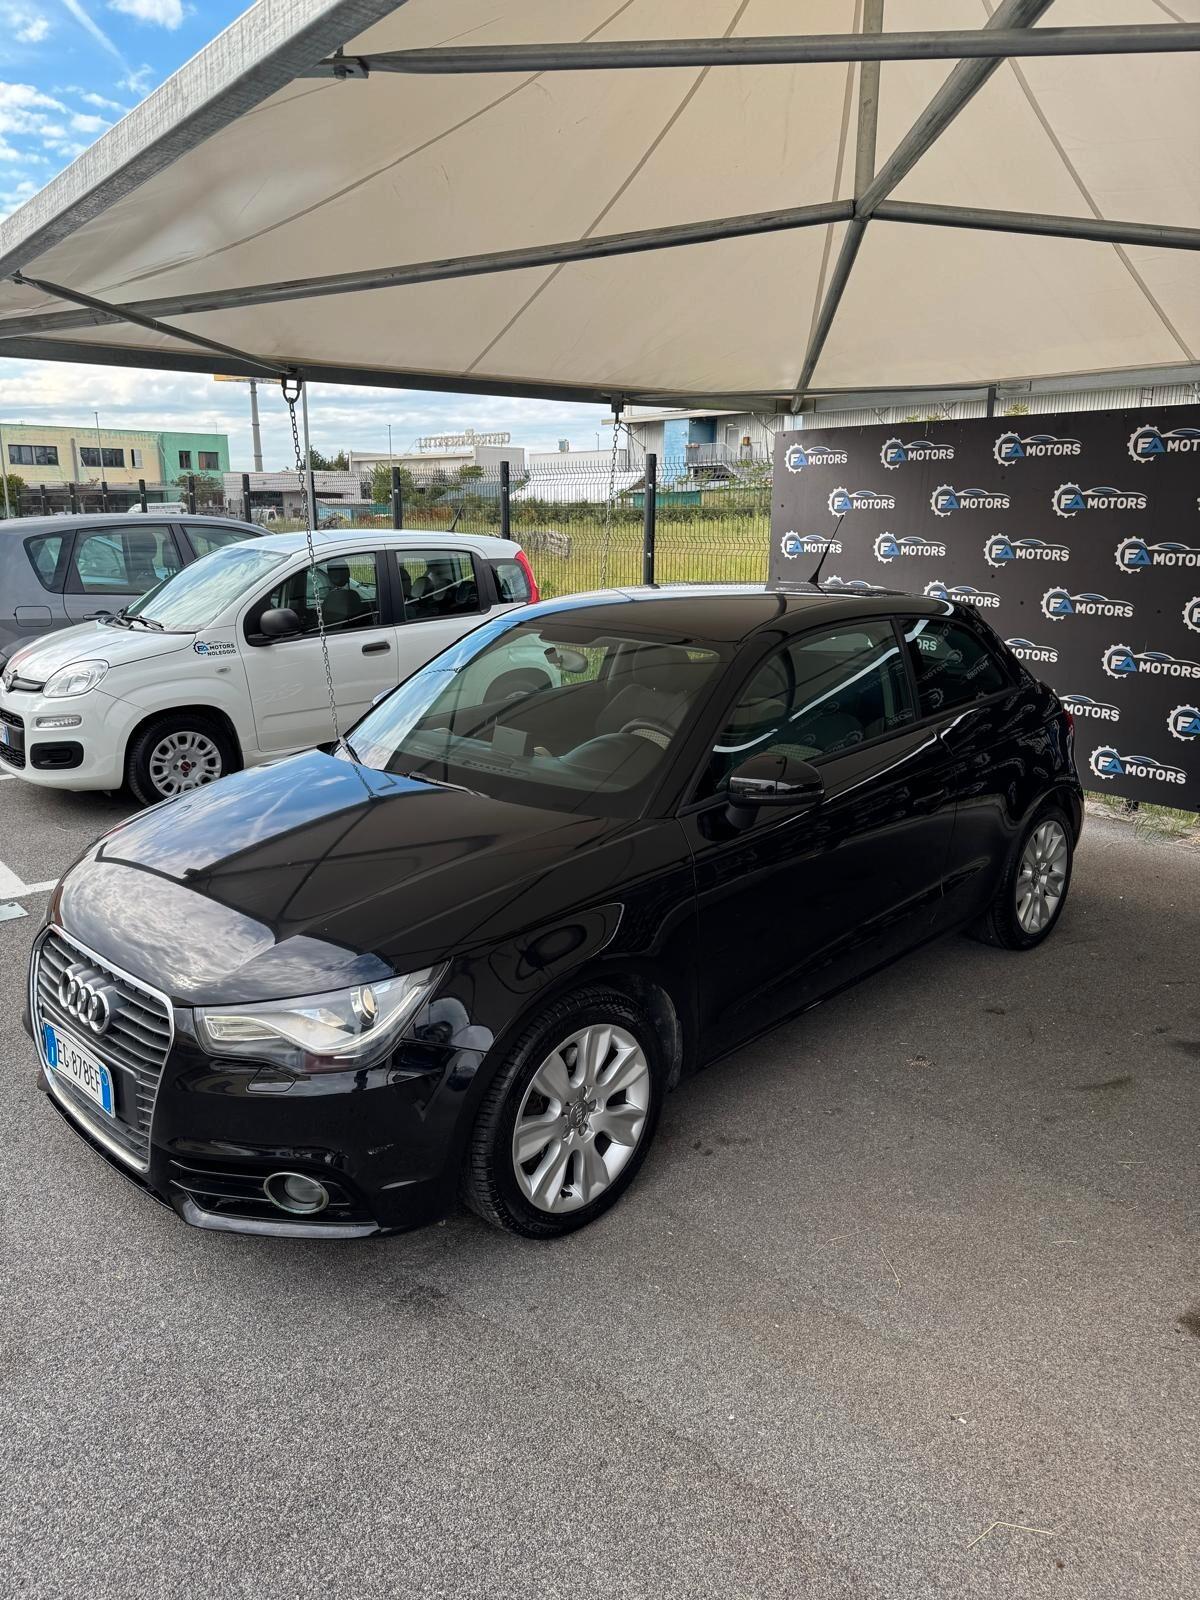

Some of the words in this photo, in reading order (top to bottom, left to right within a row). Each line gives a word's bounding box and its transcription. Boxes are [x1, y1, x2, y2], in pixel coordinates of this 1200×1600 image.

[1000, 443, 1025, 458] FA
[1026, 443, 1082, 457] MOTORS
[1136, 437, 1166, 454] FA
[790, 453, 808, 466] FA
[808, 454, 848, 466] MOTORS
[886, 448, 906, 462] FA
[908, 448, 954, 460] MOTORS
[834, 497, 852, 509] FA
[852, 498, 896, 509] MOTORS
[937, 495, 960, 510] FA
[960, 498, 1010, 509] MOTORS
[1060, 494, 1086, 510] FA
[1087, 497, 1147, 510] MOTORS
[786, 540, 803, 553] FA
[803, 543, 842, 554] MOTORS
[880, 542, 900, 556] FA
[900, 545, 946, 557] MOTORS
[991, 544, 1015, 559] FA
[1015, 548, 1070, 561] MOTORS
[1123, 548, 1152, 565] FA
[1049, 598, 1074, 614] FA
[1075, 602, 1134, 618] MOTORS
[1110, 656, 1137, 672] FA
[1139, 661, 1200, 678] MOTORS
[1064, 703, 1120, 722] MOTORS
[1098, 757, 1124, 774] FA
[1125, 763, 1187, 785] MOTORS
